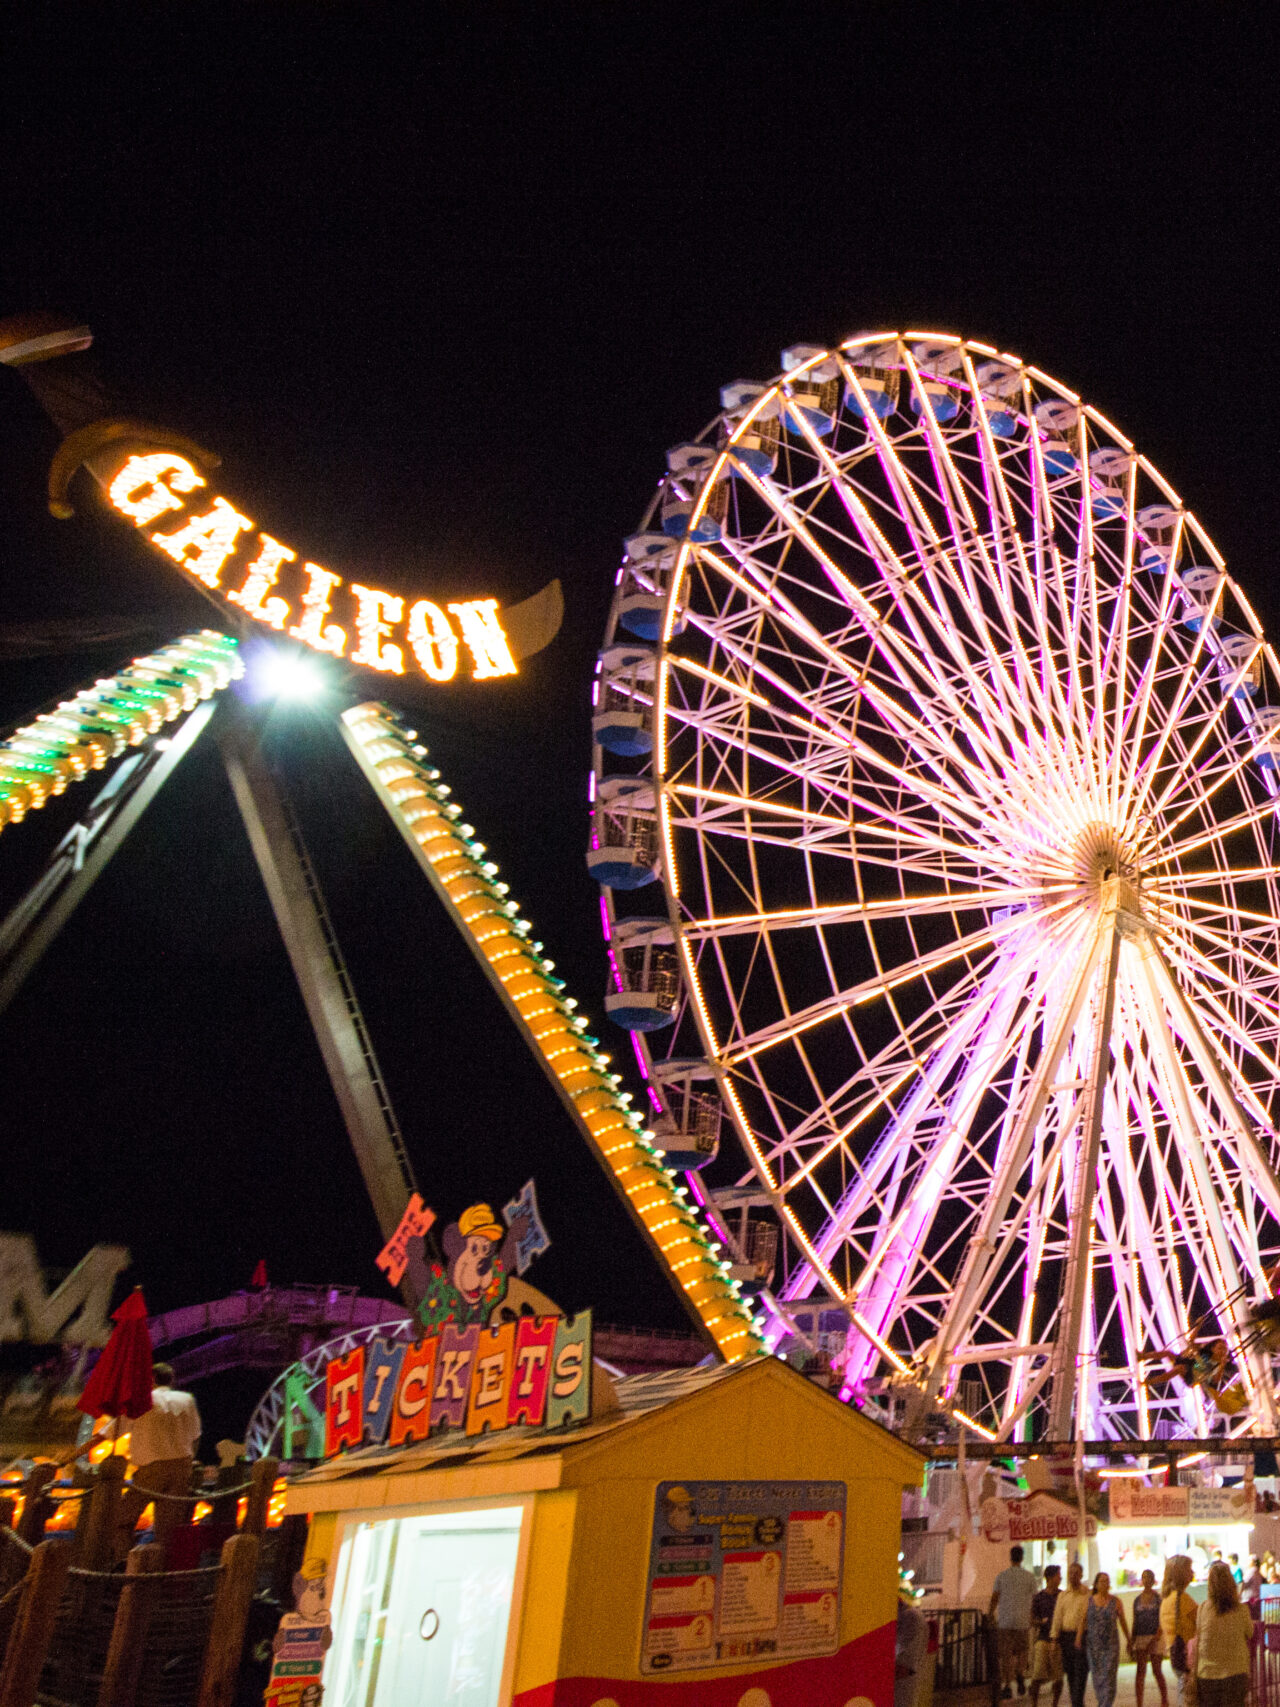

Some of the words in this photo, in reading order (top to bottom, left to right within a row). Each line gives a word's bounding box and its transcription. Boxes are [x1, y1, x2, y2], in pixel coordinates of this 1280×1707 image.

[108, 452, 519, 682] GALLEON
[332, 1340, 584, 1426] TICKETS
[1010, 1517, 1055, 1539] Kettle
[1057, 1514, 1097, 1537] Kon
